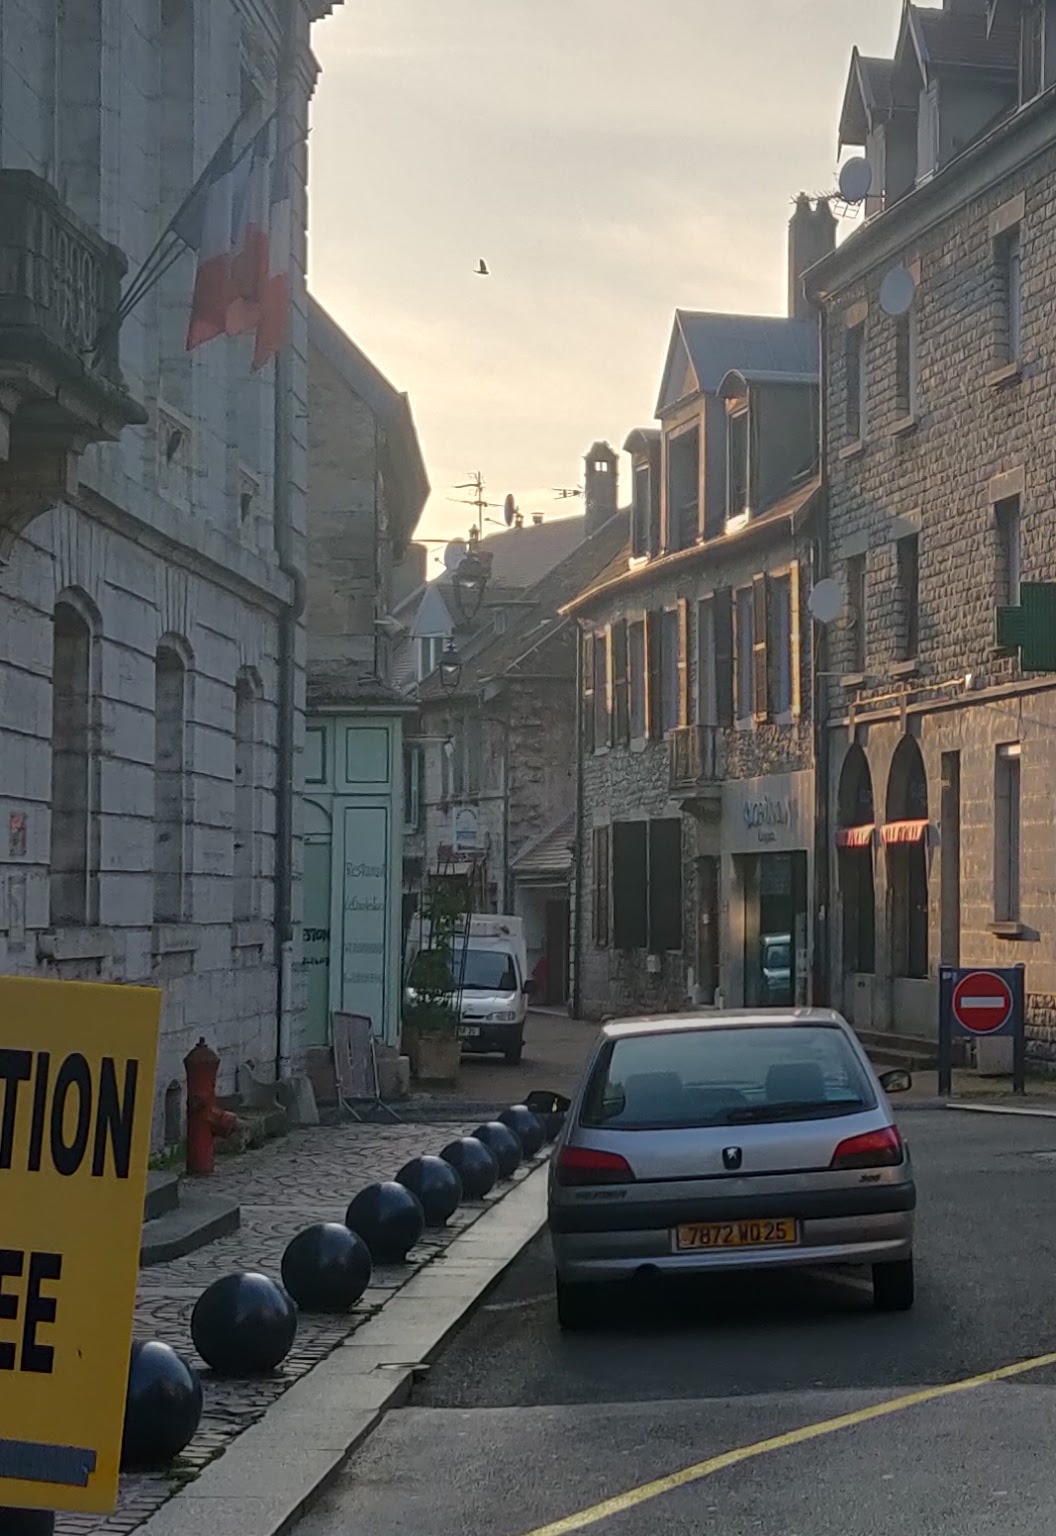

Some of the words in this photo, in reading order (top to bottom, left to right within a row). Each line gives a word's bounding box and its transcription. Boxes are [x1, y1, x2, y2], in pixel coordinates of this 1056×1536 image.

[0, 1047, 139, 1179] TION
[688, 1224, 734, 1245] 7872
[764, 1221, 787, 1241] 25
